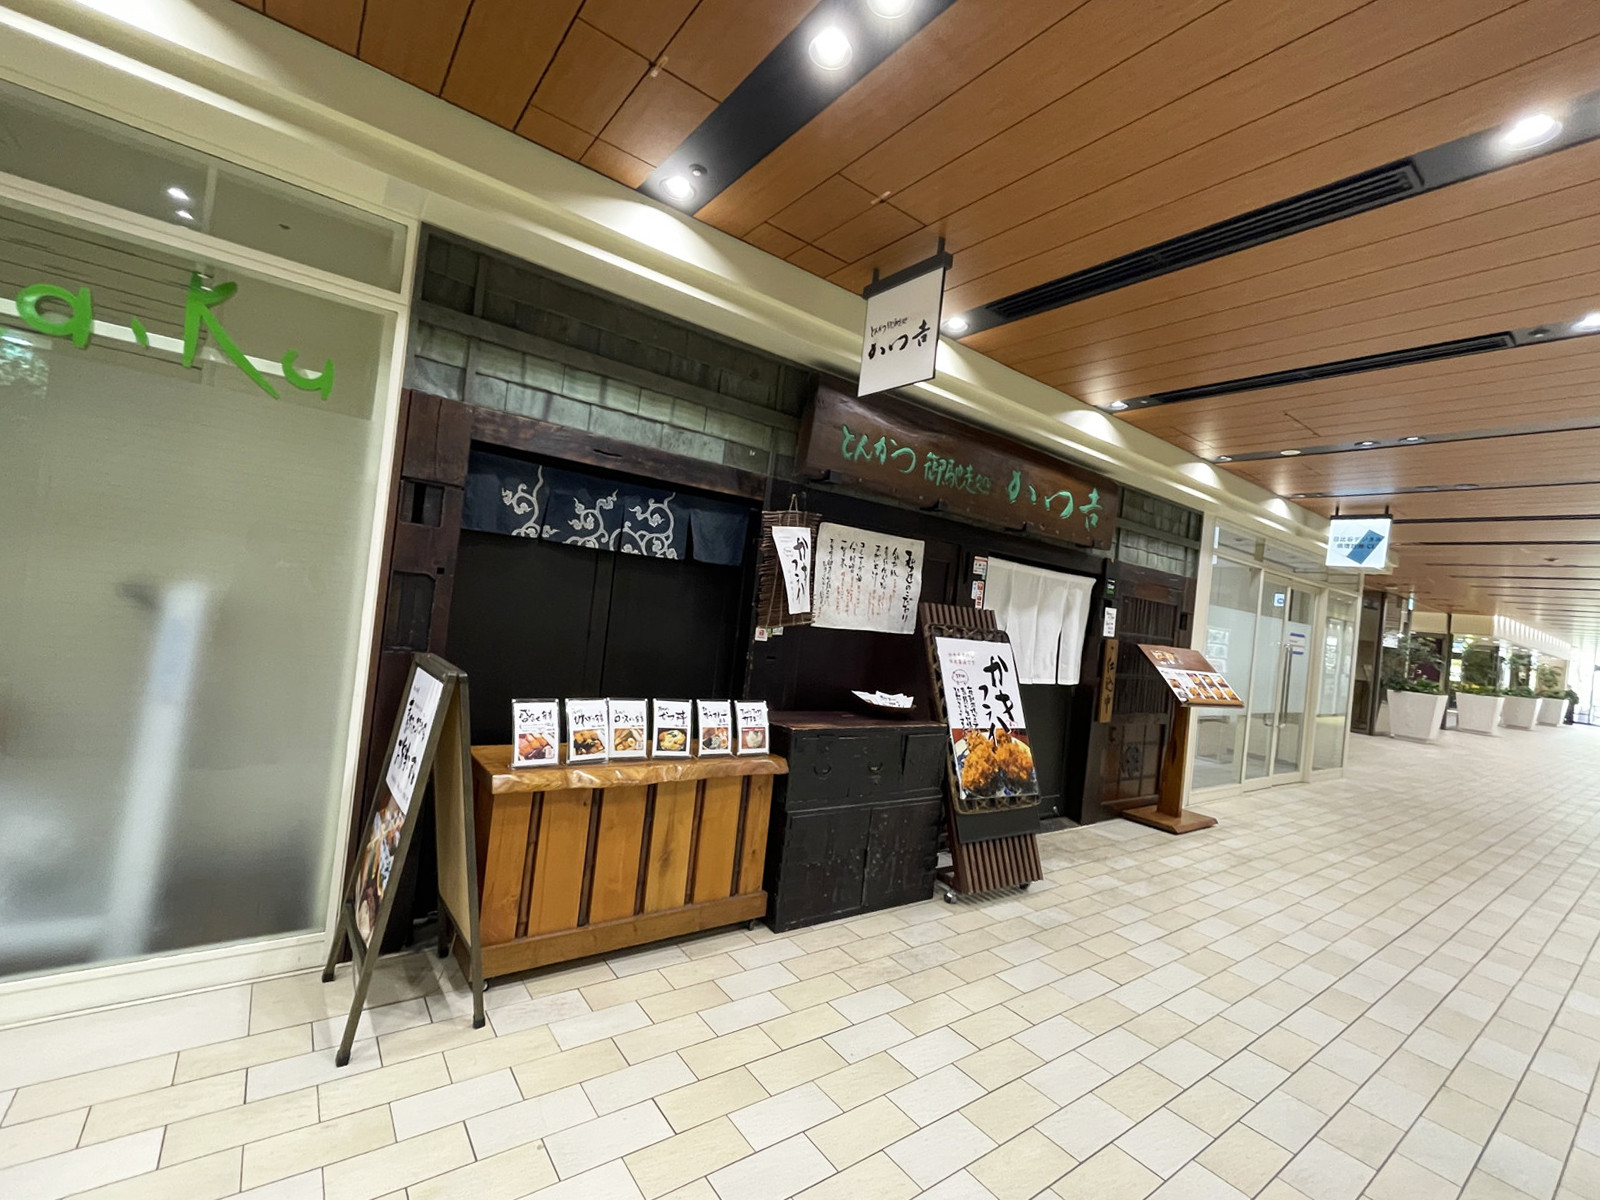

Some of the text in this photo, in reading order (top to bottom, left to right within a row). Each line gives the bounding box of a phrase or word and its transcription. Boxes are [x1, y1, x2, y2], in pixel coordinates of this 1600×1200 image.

[841, 424, 917, 474] とんかつ
[978, 685, 1011, 754] フライ
[983, 655, 1015, 723] かき
